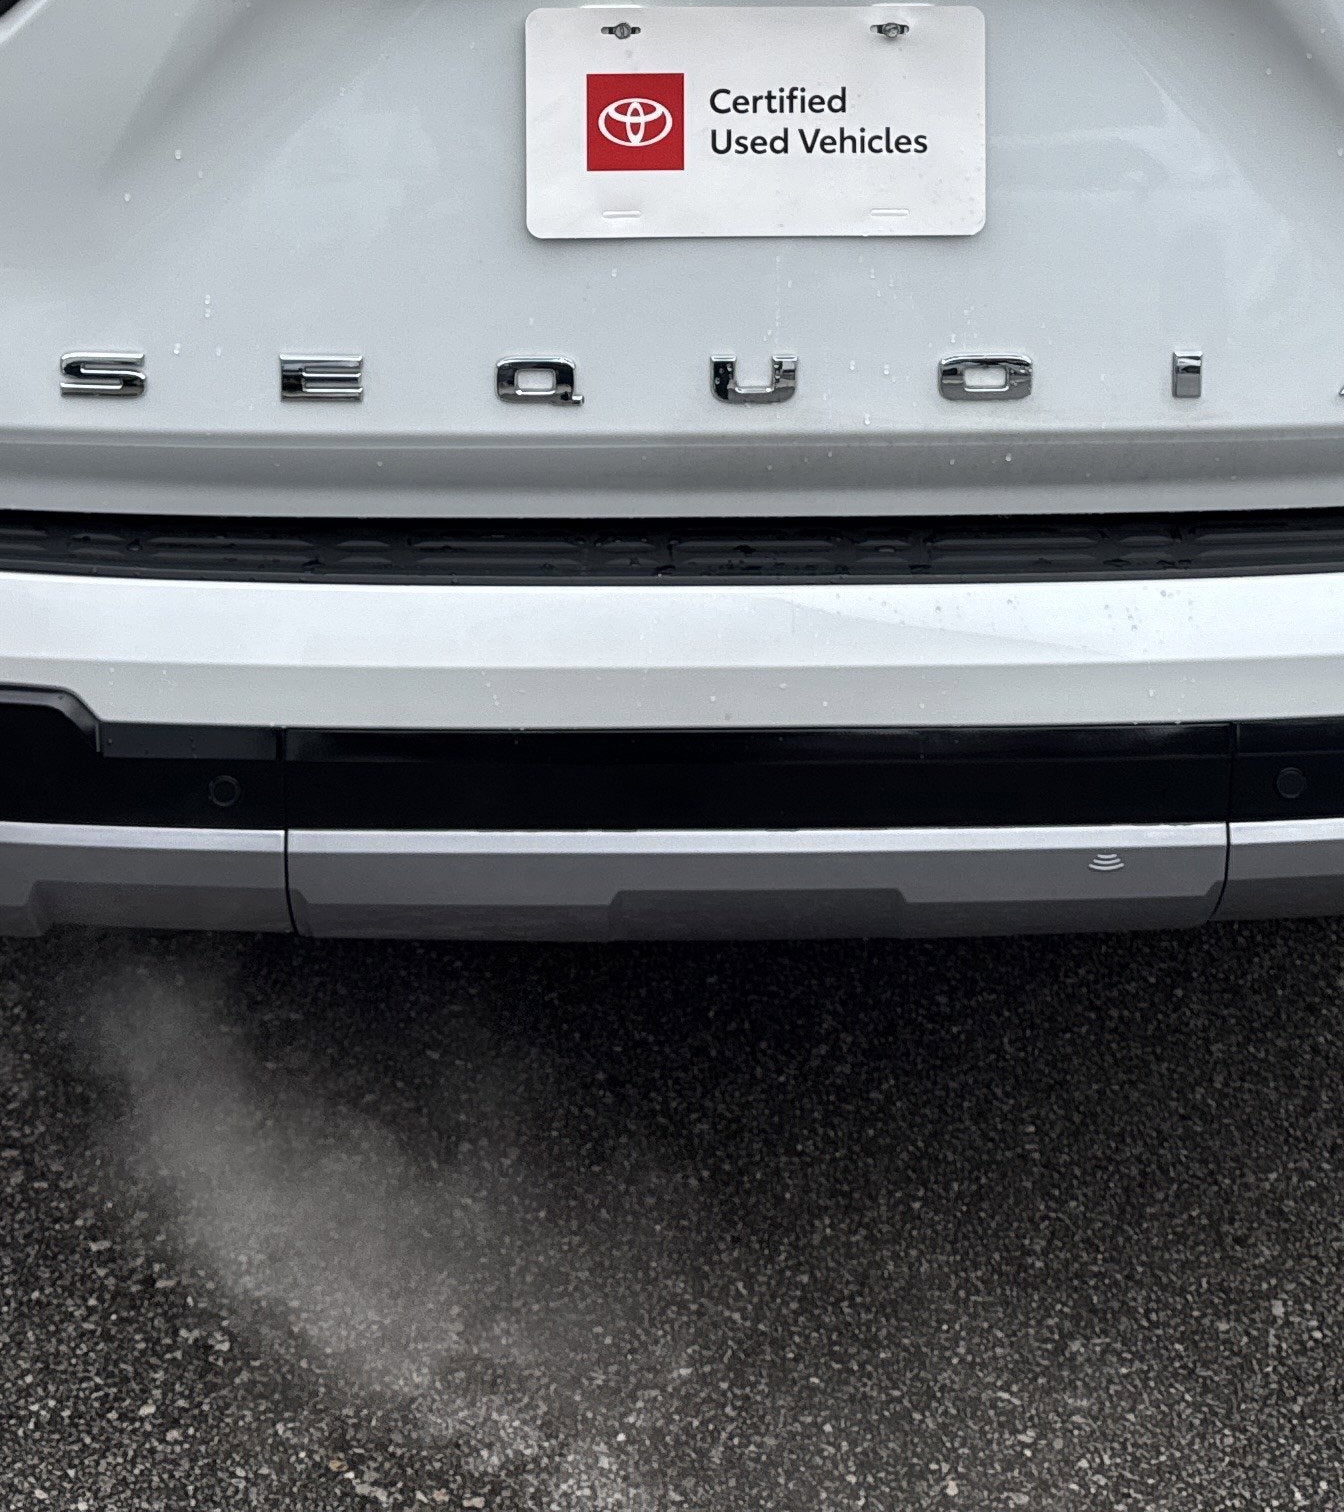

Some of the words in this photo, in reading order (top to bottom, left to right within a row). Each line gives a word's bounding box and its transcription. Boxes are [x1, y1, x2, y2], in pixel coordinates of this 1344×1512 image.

[709, 87, 847, 114] Certified
[711, 128, 789, 155] Used
[798, 127, 928, 154] Vehicles
